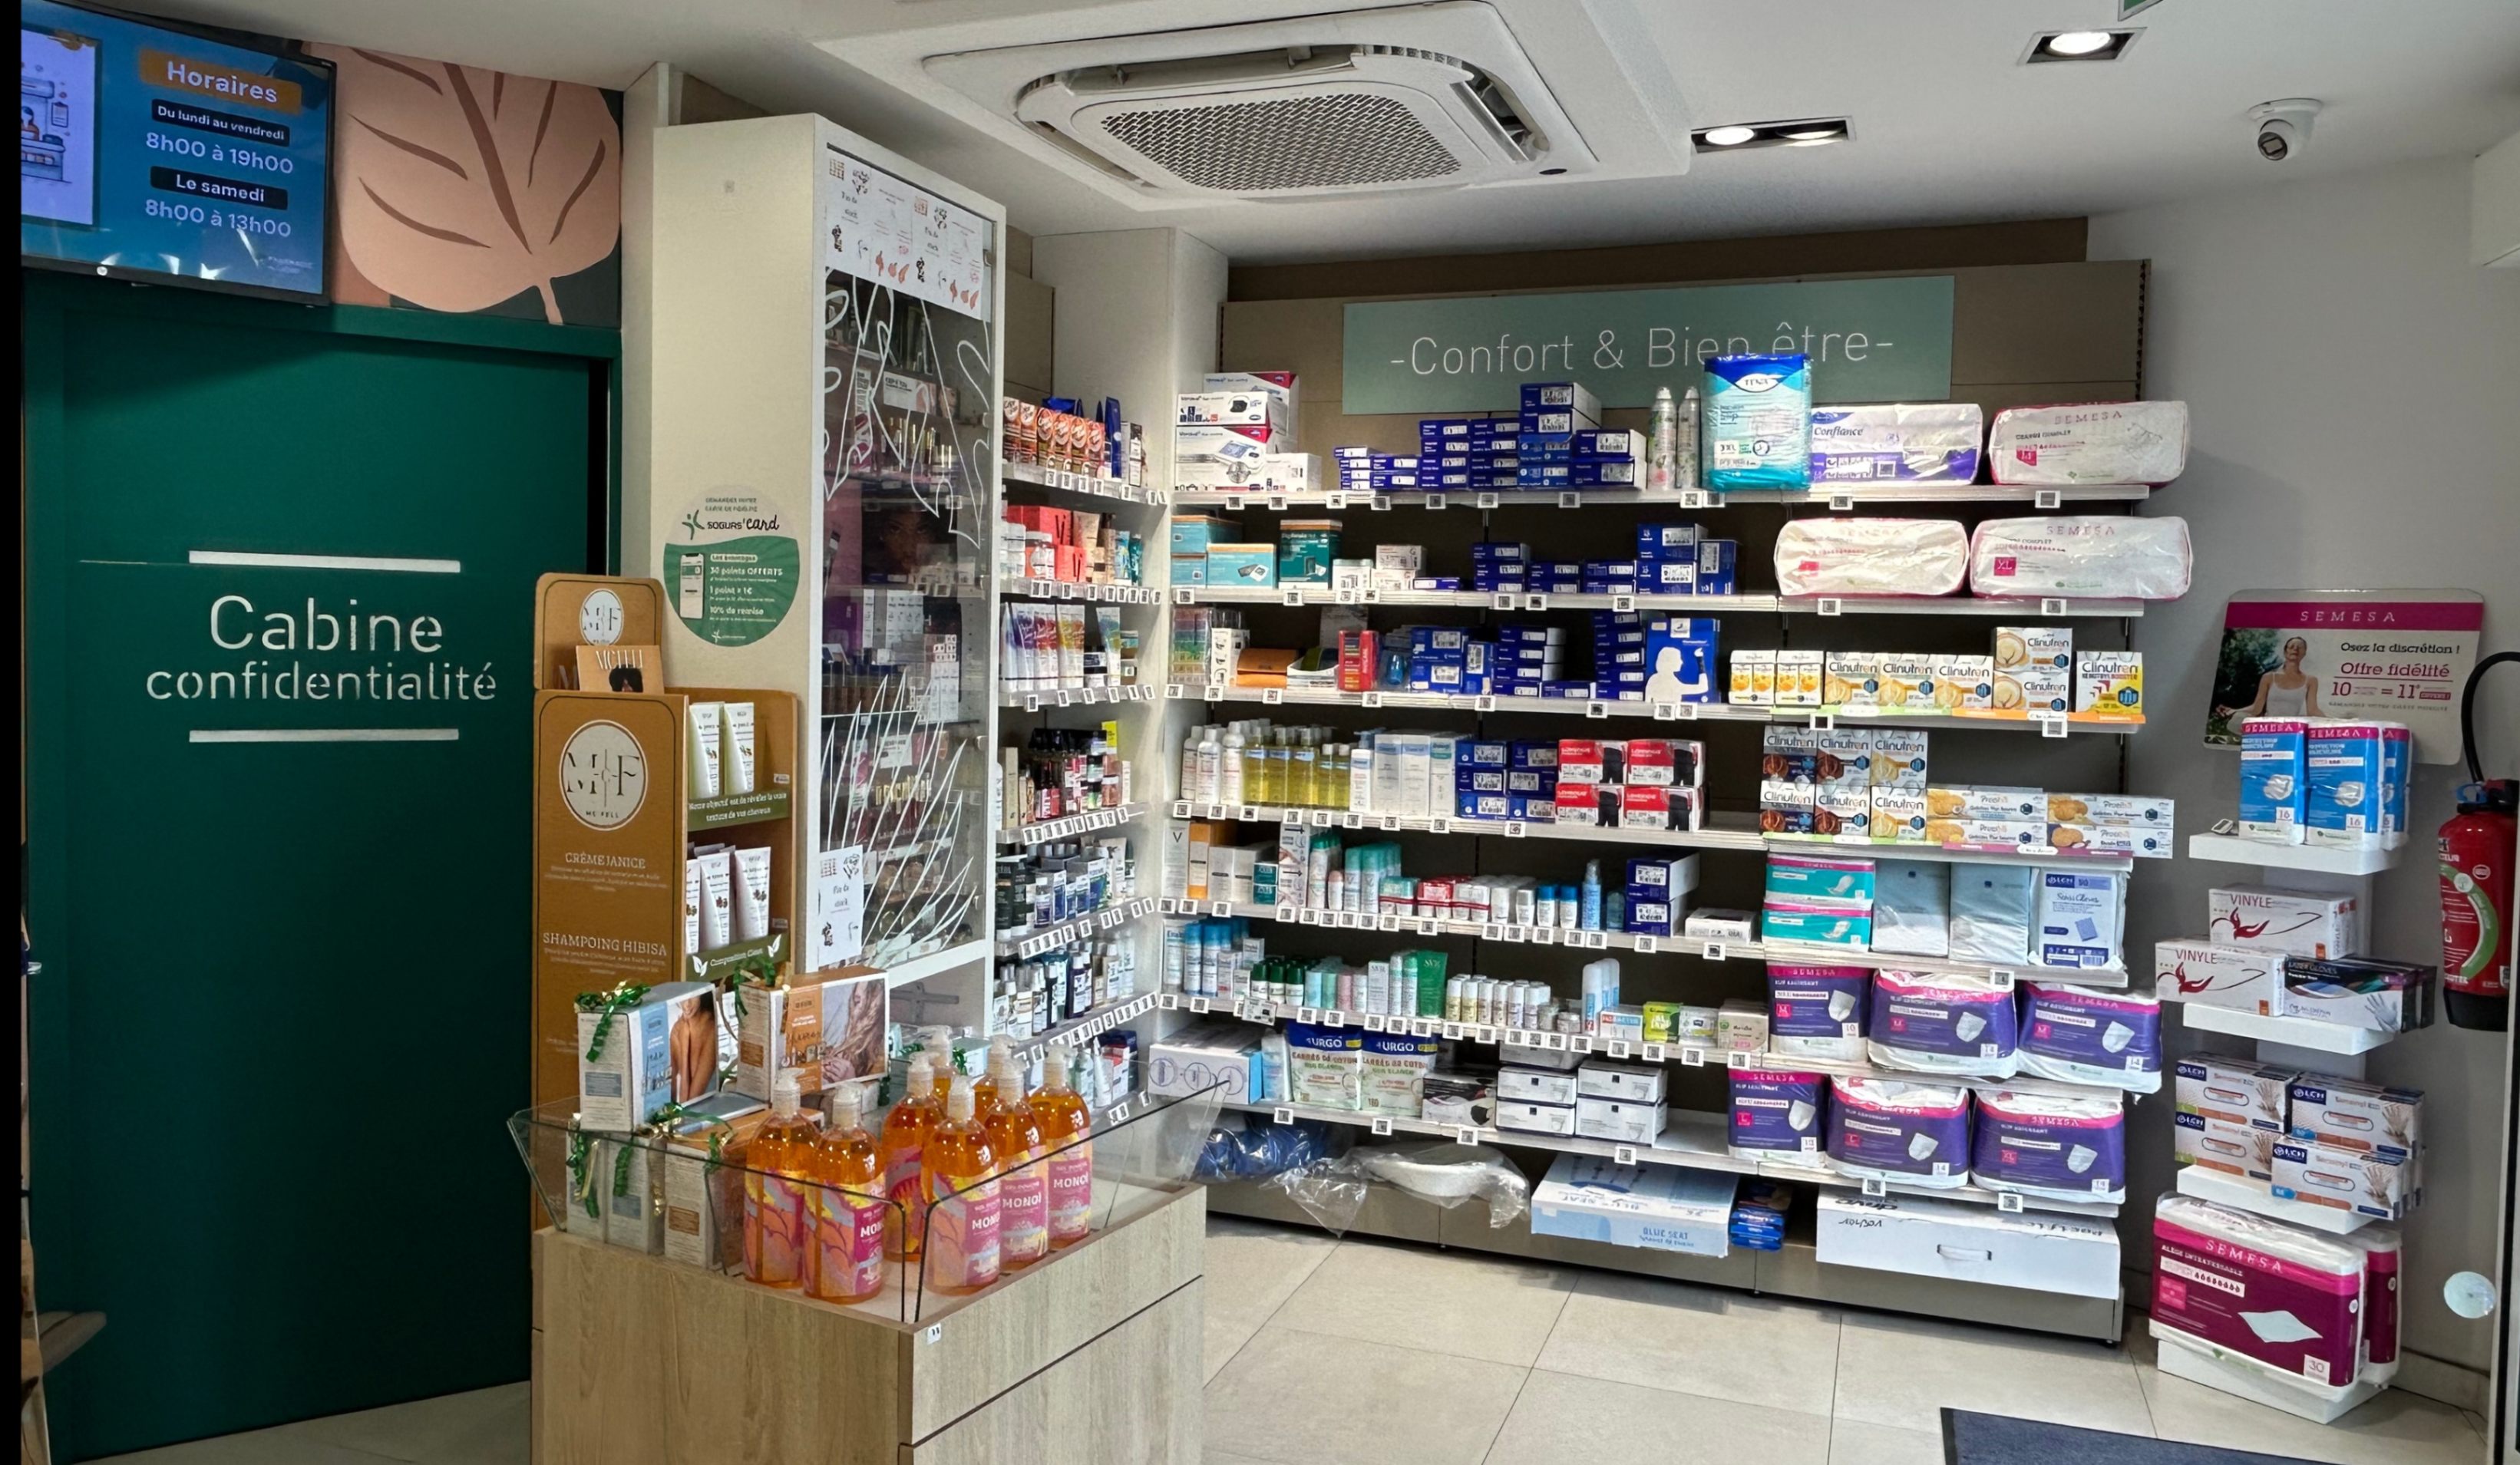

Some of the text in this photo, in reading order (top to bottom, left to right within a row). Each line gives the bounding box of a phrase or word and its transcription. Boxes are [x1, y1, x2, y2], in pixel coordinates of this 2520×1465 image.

[167, 61, 278, 104] Horaires
[157, 106, 286, 141] Du lundi au vendredi
[146, 132, 293, 174] 8h00 à 19h00
[176, 174, 265, 203] Le samedi
[145, 199, 292, 237] 8h00 à 13h00
[1594, 330, 1623, 369] &
[1649, 328, 1749, 367] Bien
[1814, 426, 1864, 437] Confiance
[2300, 611, 2396, 623] SEMESA
[210, 596, 443, 652] Cabine
[2028, 637, 2069, 648] Clinutren
[2340, 642, 2370, 653] Osez
[2373, 642, 2386, 653] la
[2389, 642, 2453, 655] discrétion
[1828, 662, 1878, 674] Clinutren
[1883, 663, 1933, 675] Clinutren
[1939, 665, 1990, 678] Clinutren
[2082, 662, 2139, 674] Clinutren
[2340, 662, 2450, 678] Offre fidélité
[147, 661, 497, 701] confidentialité
[2024, 681, 2066, 692] Clinutren
[2331, 681, 2352, 697] 10
[1766, 735, 1815, 747] Clinutren
[1821, 737, 1869, 751] Clinutren
[1875, 739, 1924, 752] Clinutren
[1764, 790, 1812, 804] Clinutren
[1818, 794, 1867, 808] Clinutren
[1875, 797, 1924, 810] Clinutren
[2279, 810, 2290, 820] 16
[2350, 817, 2361, 827] 16
[606, 856, 646, 869] JANICE
[2230, 894, 2273, 909] VINYLE
[543, 932, 668, 957] SHAMPOING HIBISA
[2175, 949, 2218, 965] VINYLE
[1311, 1038, 1343, 1048] URGO
[1382, 1042, 1415, 1052] URGO
[2188, 1067, 2205, 1076] LCH
[2304, 1090, 2325, 1100] LCH
[2186, 1116, 2204, 1126] LCH
[2284, 1148, 2305, 1158] LCH
[1936, 1163, 1947, 1172] 14
[2205, 1239, 2284, 1275] SEMESA
[2308, 1358, 2325, 1374] 30
